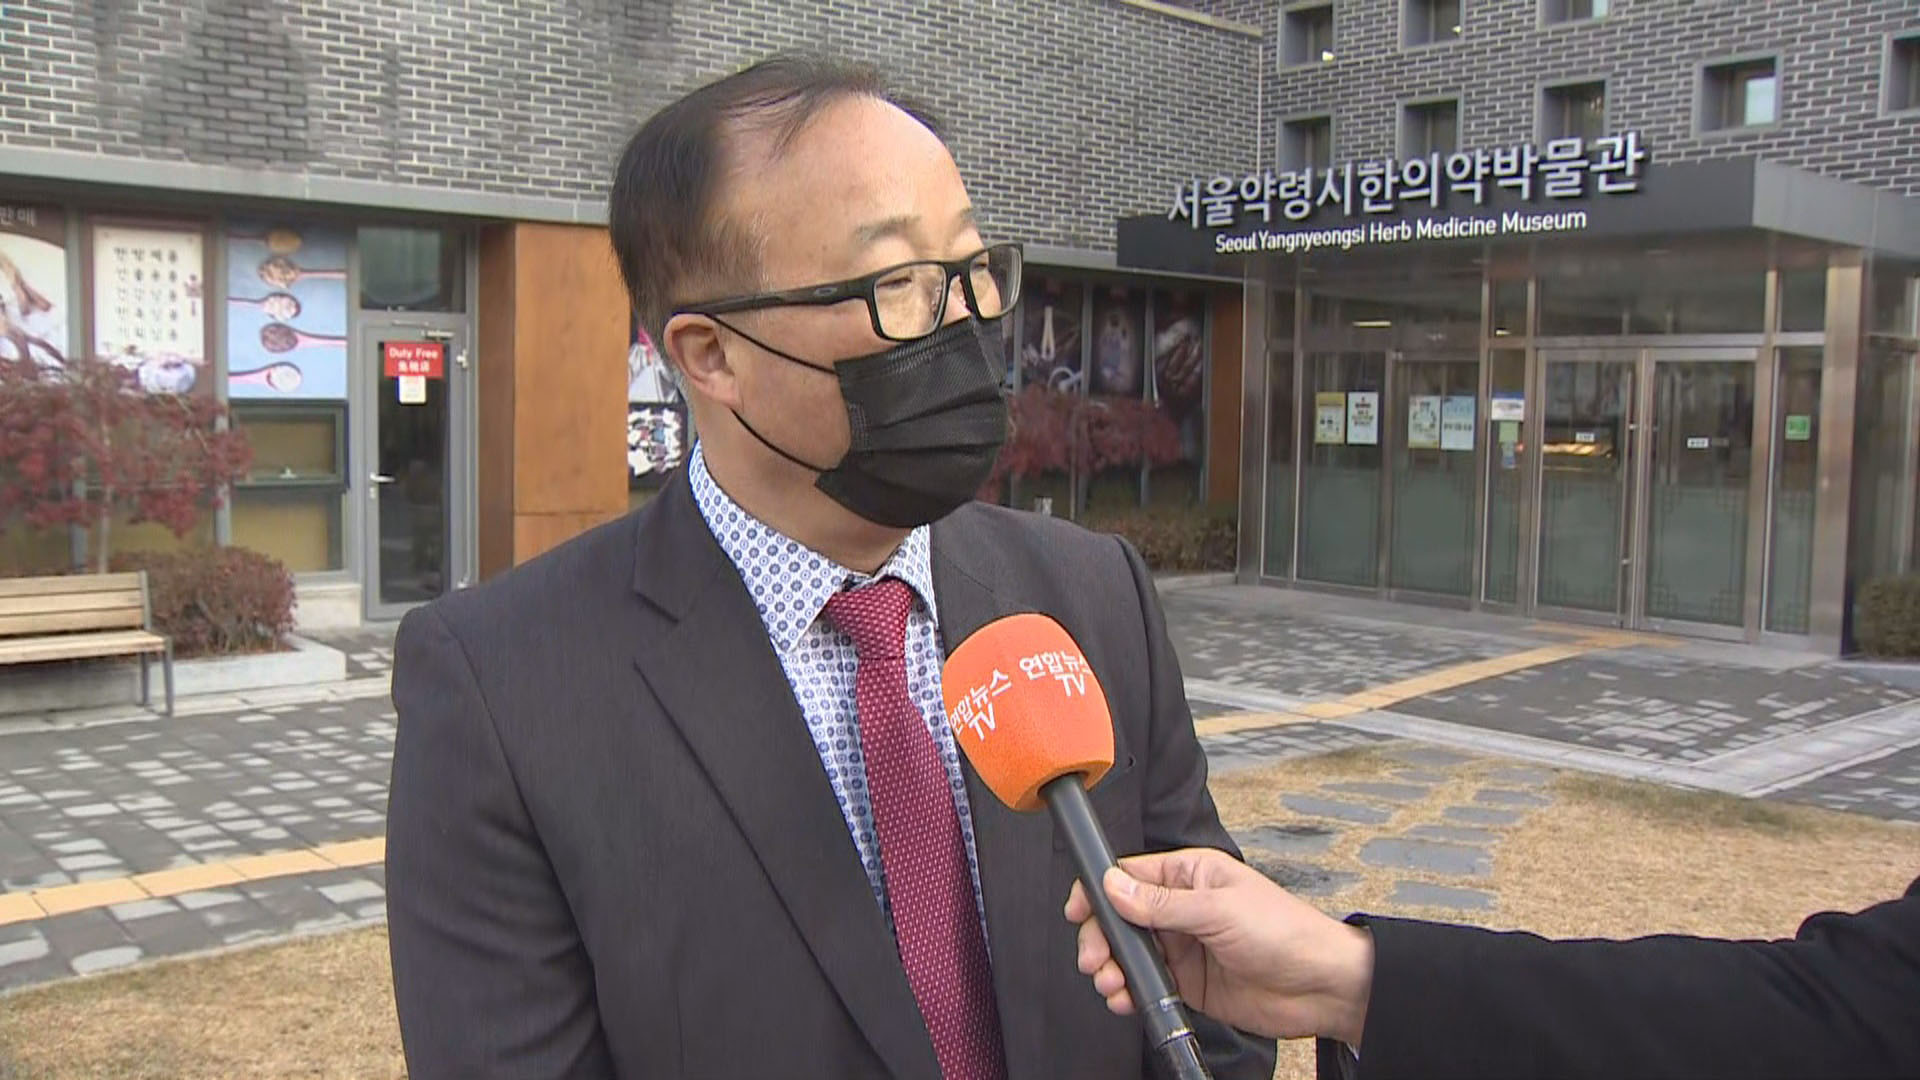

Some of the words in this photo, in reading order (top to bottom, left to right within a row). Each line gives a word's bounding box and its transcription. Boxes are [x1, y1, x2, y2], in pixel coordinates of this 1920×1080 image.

[1167, 131, 1646, 230] 서울약령시한의약박물관
[1215, 232, 1257, 254] Seoul
[1257, 224, 1366, 254] Yangnyeongsi
[1369, 219, 1412, 244] Herb
[1416, 214, 1497, 240] Medicine
[1501, 209, 1588, 234] Museum
[389, 347, 412, 361] Duty
[416, 347, 439, 360] Free
[949, 668, 1012, 736] 연합뉴스
[1054, 673, 1086, 697] TV
[968, 701, 996, 741] TV
